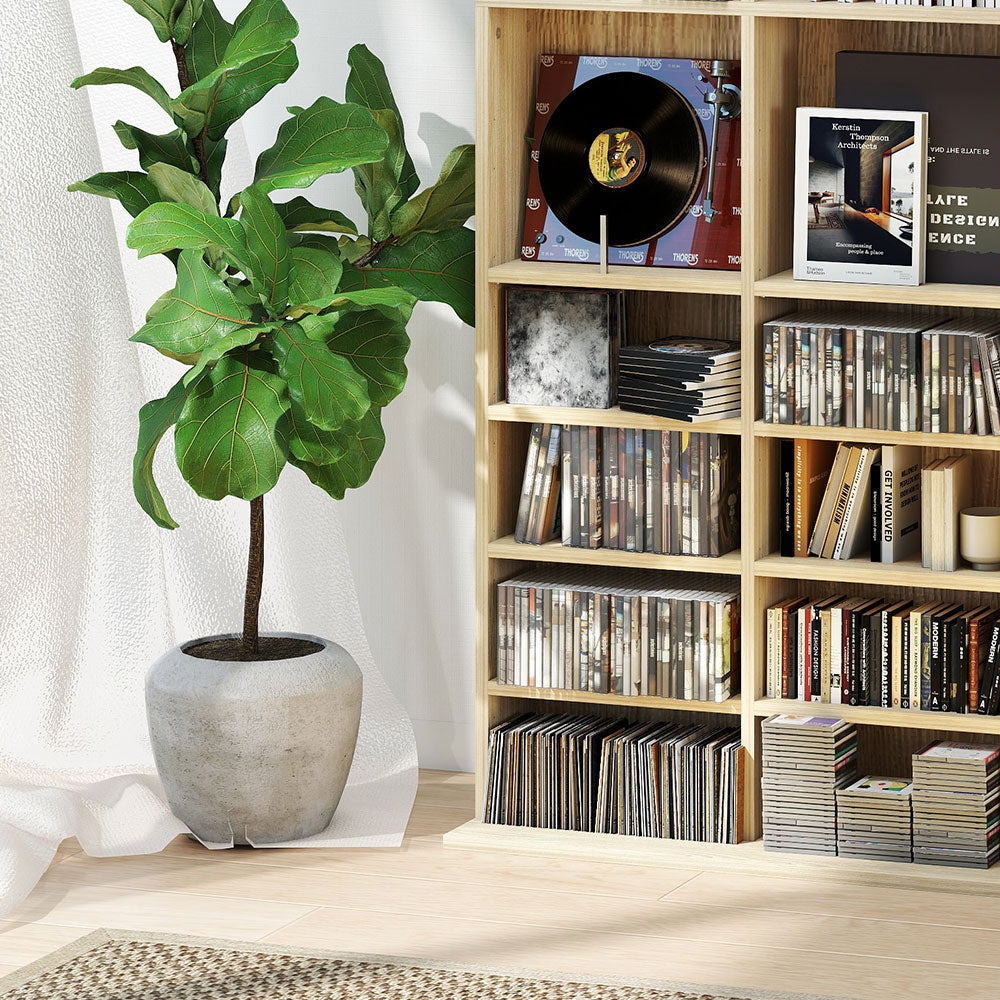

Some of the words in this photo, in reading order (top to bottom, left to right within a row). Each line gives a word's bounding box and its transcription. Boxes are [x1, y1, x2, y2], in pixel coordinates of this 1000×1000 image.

[540, 56, 554, 67] RENS
[582, 56, 608, 69] THORENS
[636, 58, 662, 70] THORENS
[536, 102, 550, 114] RENS
[832, 123, 860, 132] Kerstin
[850, 132, 890, 142] Thompson
[838, 142, 878, 150] Architects
[526, 198, 540, 210] RENS
[521, 246, 536, 258] RENS
[835, 242, 872, 250] Encompassing
[564, 248, 589, 261] THORENS
[618, 250, 644, 263] THORENS
[672, 252, 699, 266] THORENS
[884, 470, 892, 489] GET
[834, 482, 850, 525] MINIMALISM
[884, 492, 892, 542] INVOLVED
[988, 626, 999, 663] MODERN
